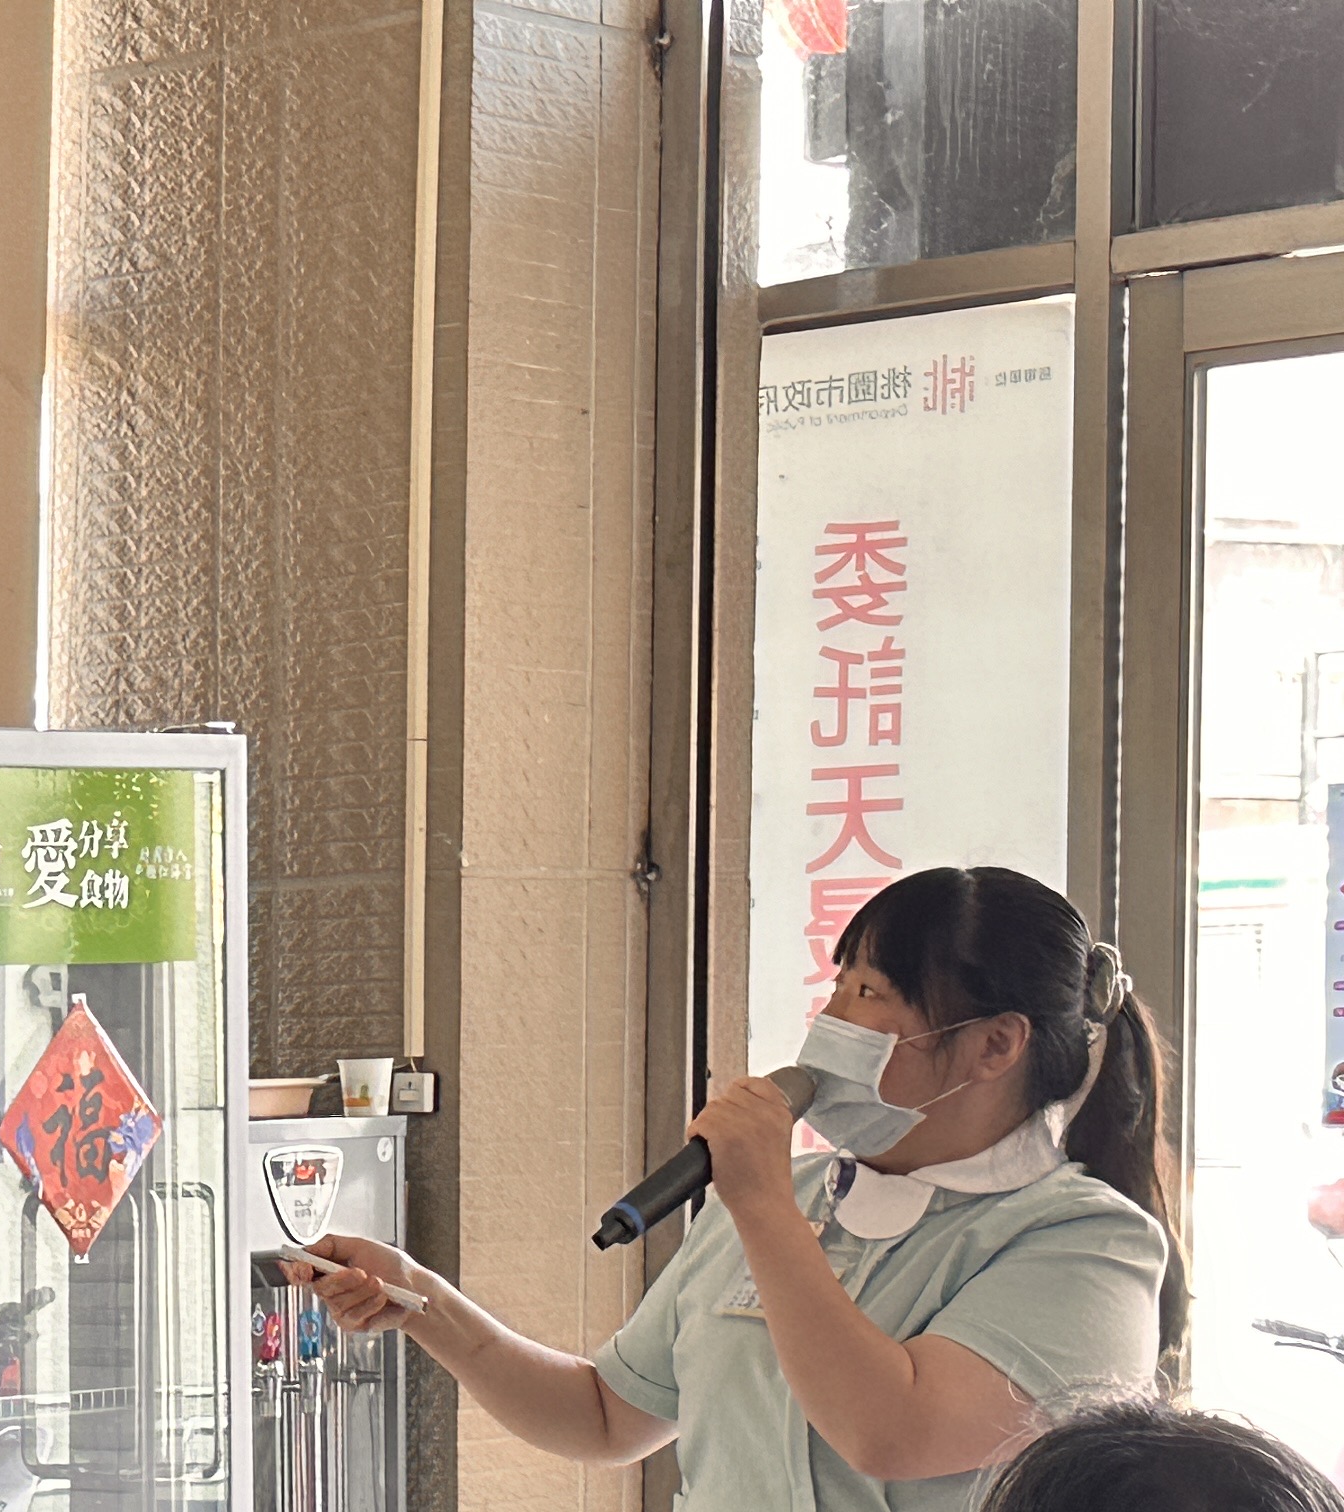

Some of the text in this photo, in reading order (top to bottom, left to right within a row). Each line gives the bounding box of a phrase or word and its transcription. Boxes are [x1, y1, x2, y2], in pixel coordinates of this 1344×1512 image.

[21, 811, 129, 909] 愛 分享
[79, 868, 130, 909] 食物
